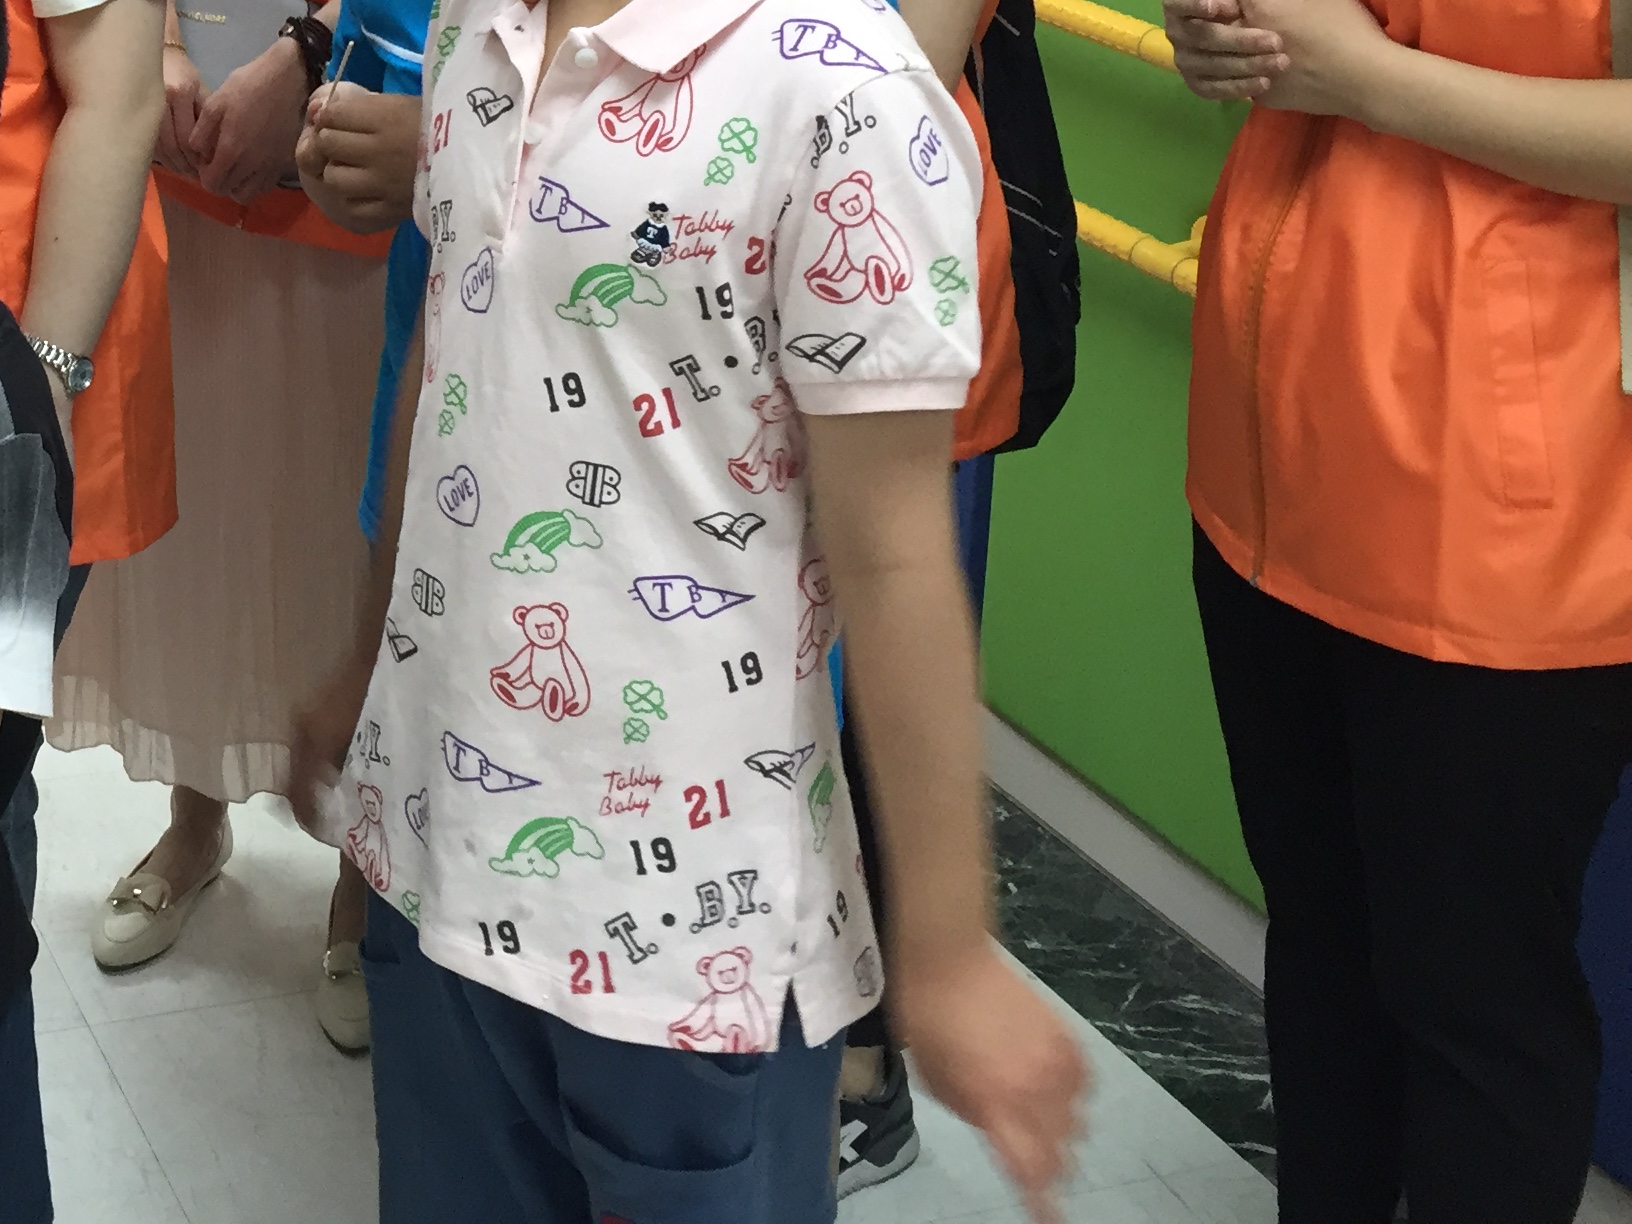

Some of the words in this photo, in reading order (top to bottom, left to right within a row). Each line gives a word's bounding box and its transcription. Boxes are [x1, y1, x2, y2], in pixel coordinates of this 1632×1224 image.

[672, 209, 735, 241] Tabby
[662, 237, 717, 265] Baby
[465, 261, 492, 302] LOVE
[695, 282, 734, 321] 19
[543, 372, 587, 413] 19
[632, 387, 681, 438] 21
[443, 477, 474, 512] LOVE
[721, 651, 763, 693] 19
[603, 765, 664, 793] Tabby
[599, 792, 651, 818] Baby
[683, 779, 731, 830] 21
[629, 837, 677, 875] 19
[826, 889, 848, 938] 19
[478, 920, 521, 956] 19
[569, 949, 616, 994] 21
